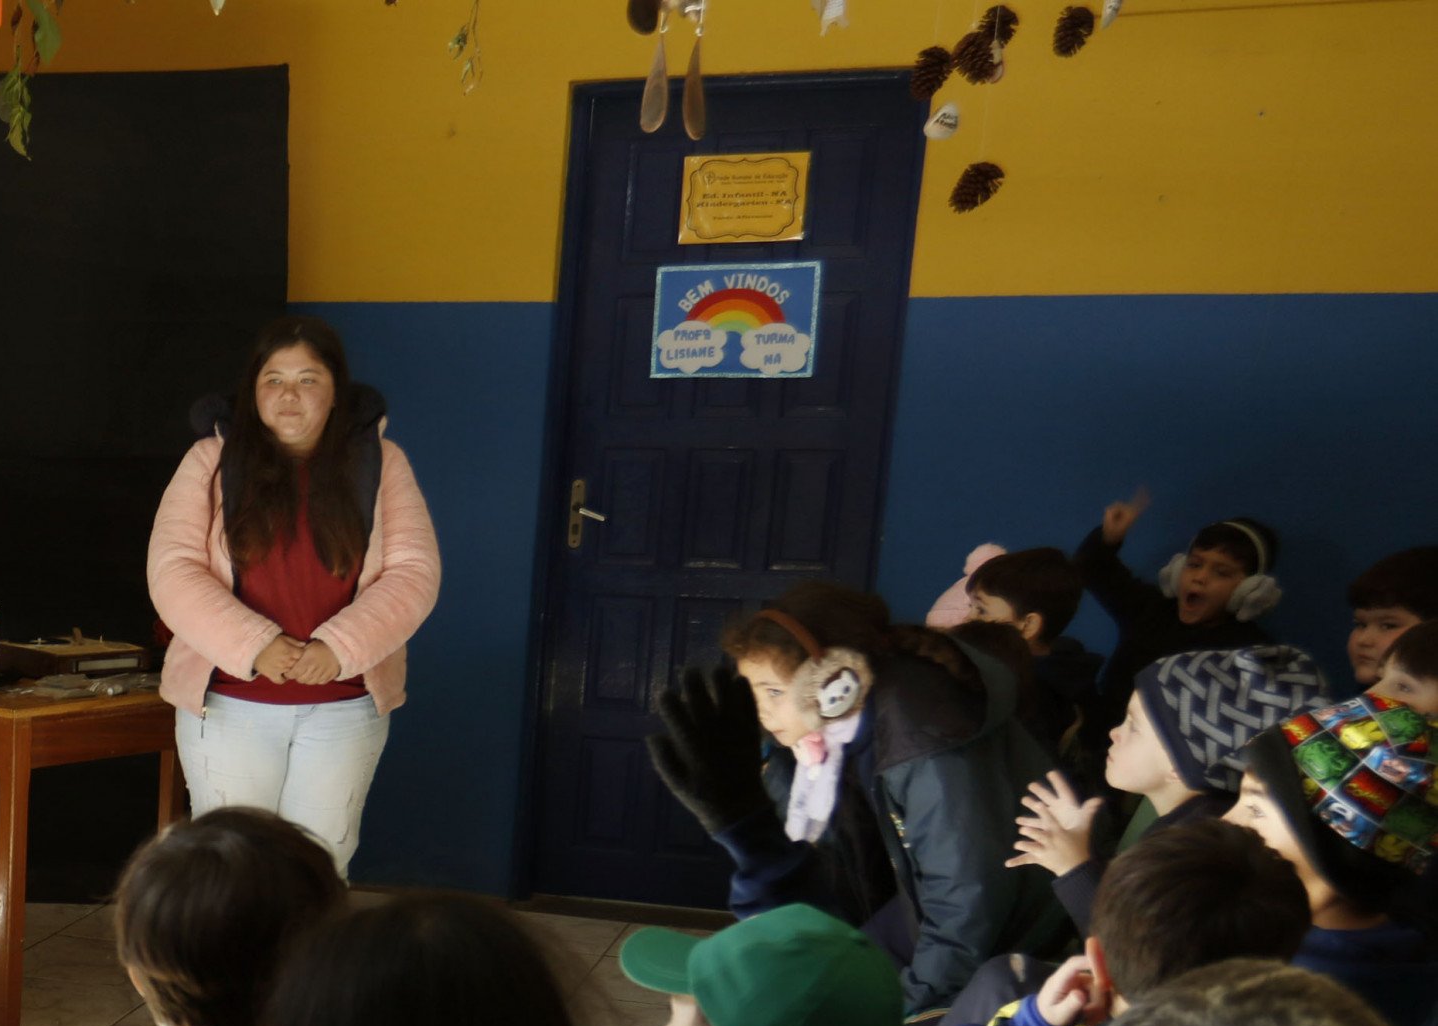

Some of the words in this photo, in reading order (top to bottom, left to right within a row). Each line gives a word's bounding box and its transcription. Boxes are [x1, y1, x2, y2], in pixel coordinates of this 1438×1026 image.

[678, 280, 714, 313] BEM
[723, 273, 791, 305] VINDOS
[754, 332, 795, 345] TURMA
[666, 346, 715, 360] LISIANE
